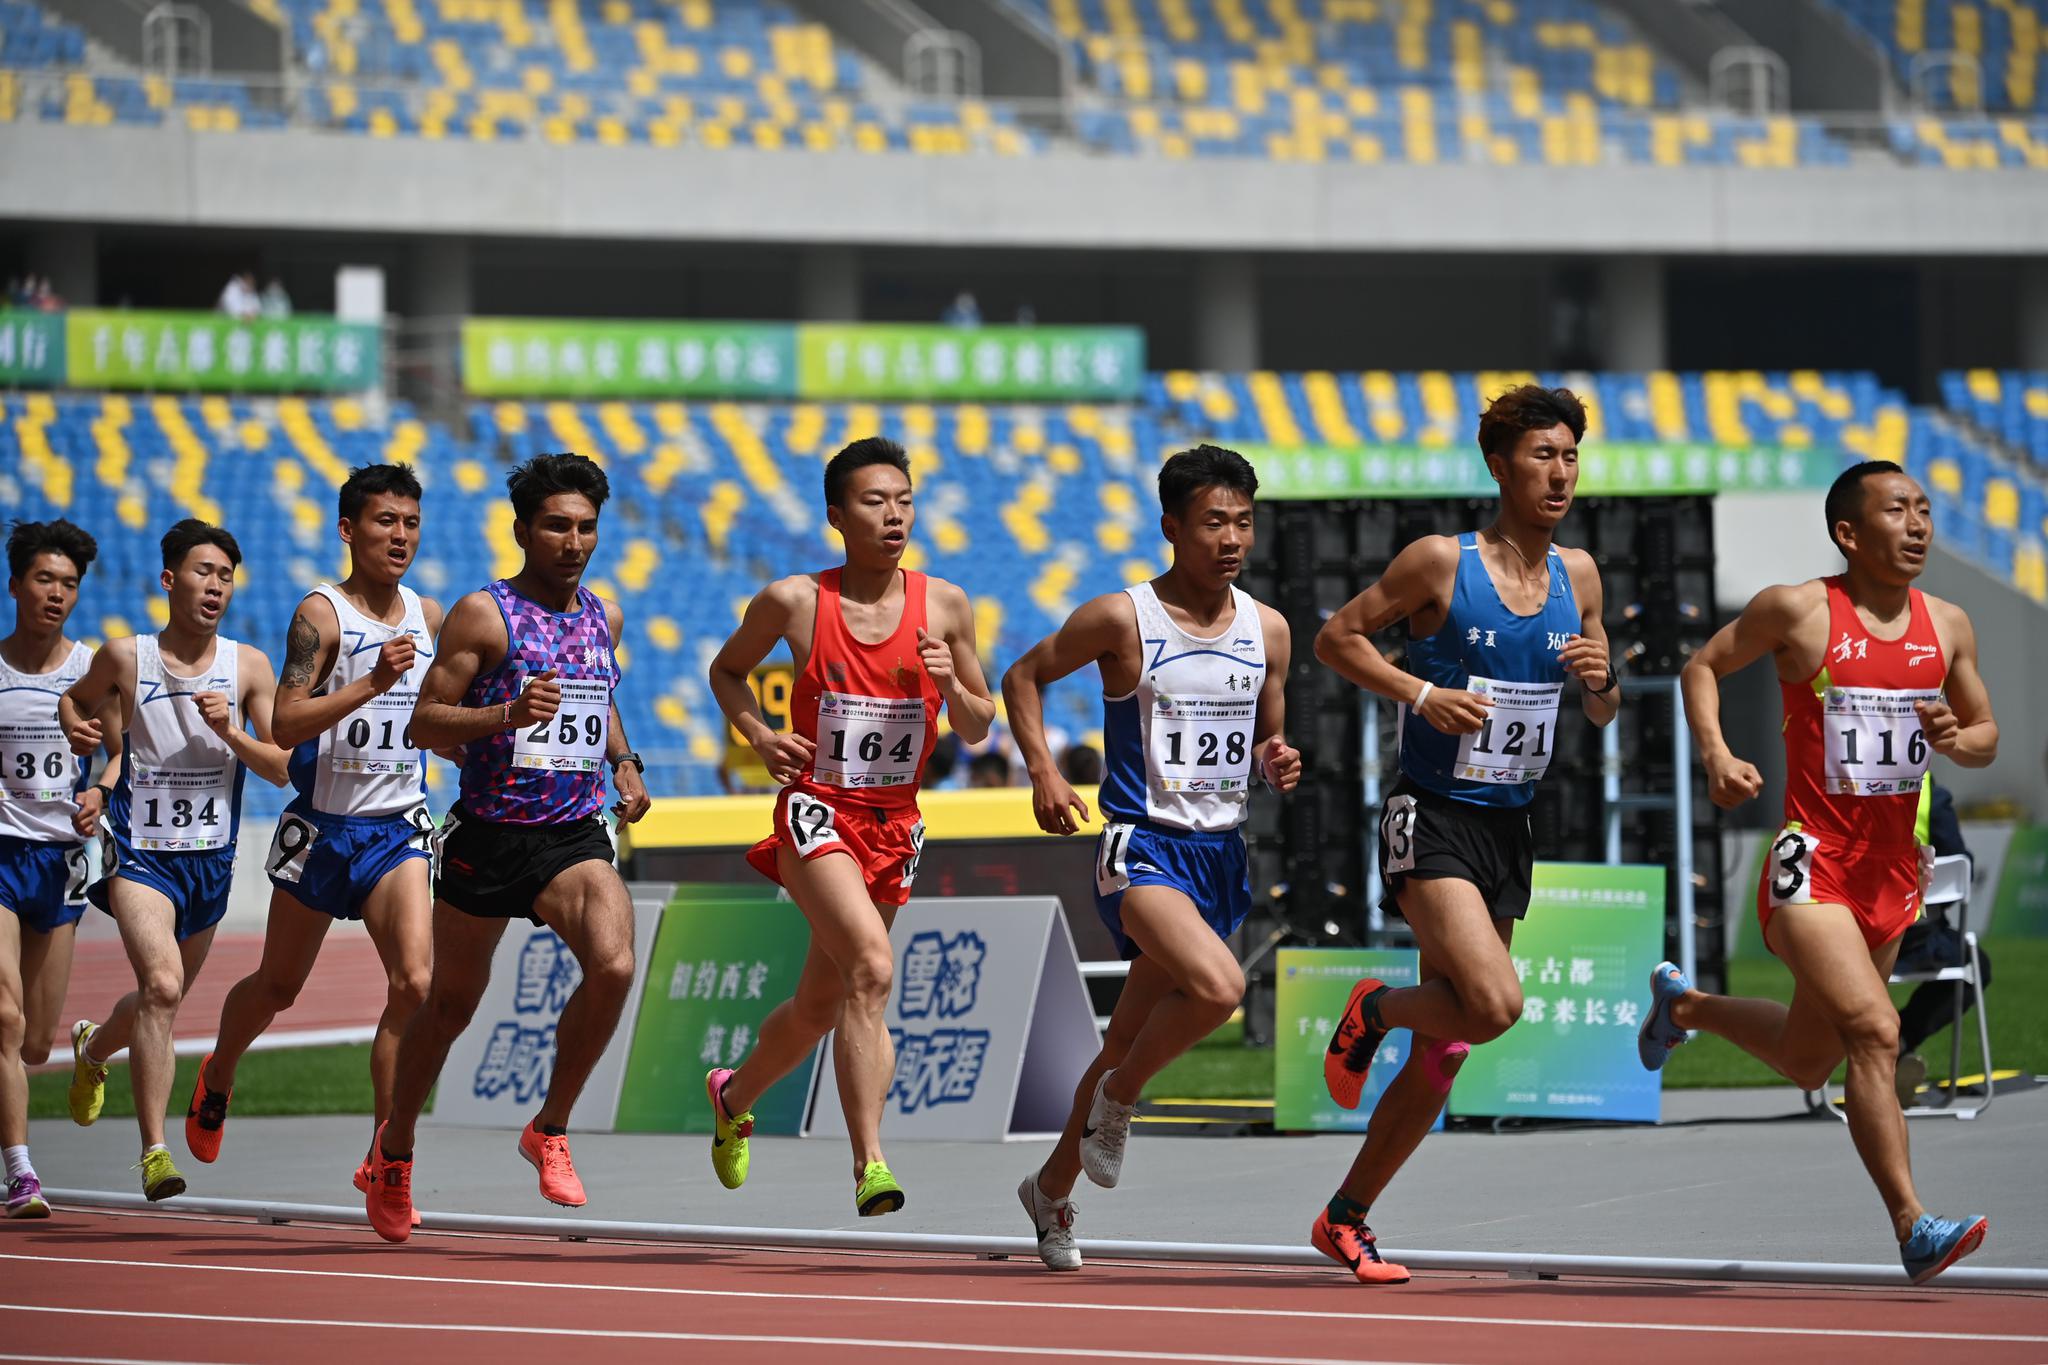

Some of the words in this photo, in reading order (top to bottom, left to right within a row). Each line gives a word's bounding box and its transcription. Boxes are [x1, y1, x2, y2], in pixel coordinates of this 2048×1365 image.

[1904, 642, 1936, 653] Do-win
[1225, 673, 1251, 691] 青海
[527, 714, 602, 746] 259
[828, 729, 913, 763] 164
[1164, 731, 1246, 766] 128
[1472, 718, 1547, 757] 121
[1840, 728, 1927, 766] 116
[143, 797, 219, 828] 134
[791, 801, 830, 847] 12
[273, 817, 310, 872] 9
[69, 849, 89, 901] 2
[1772, 833, 1807, 900] 3
[669, 959, 769, 1000] 相约西安
[898, 930, 987, 1020] 雪花
[1522, 996, 1639, 1026] 常来长安
